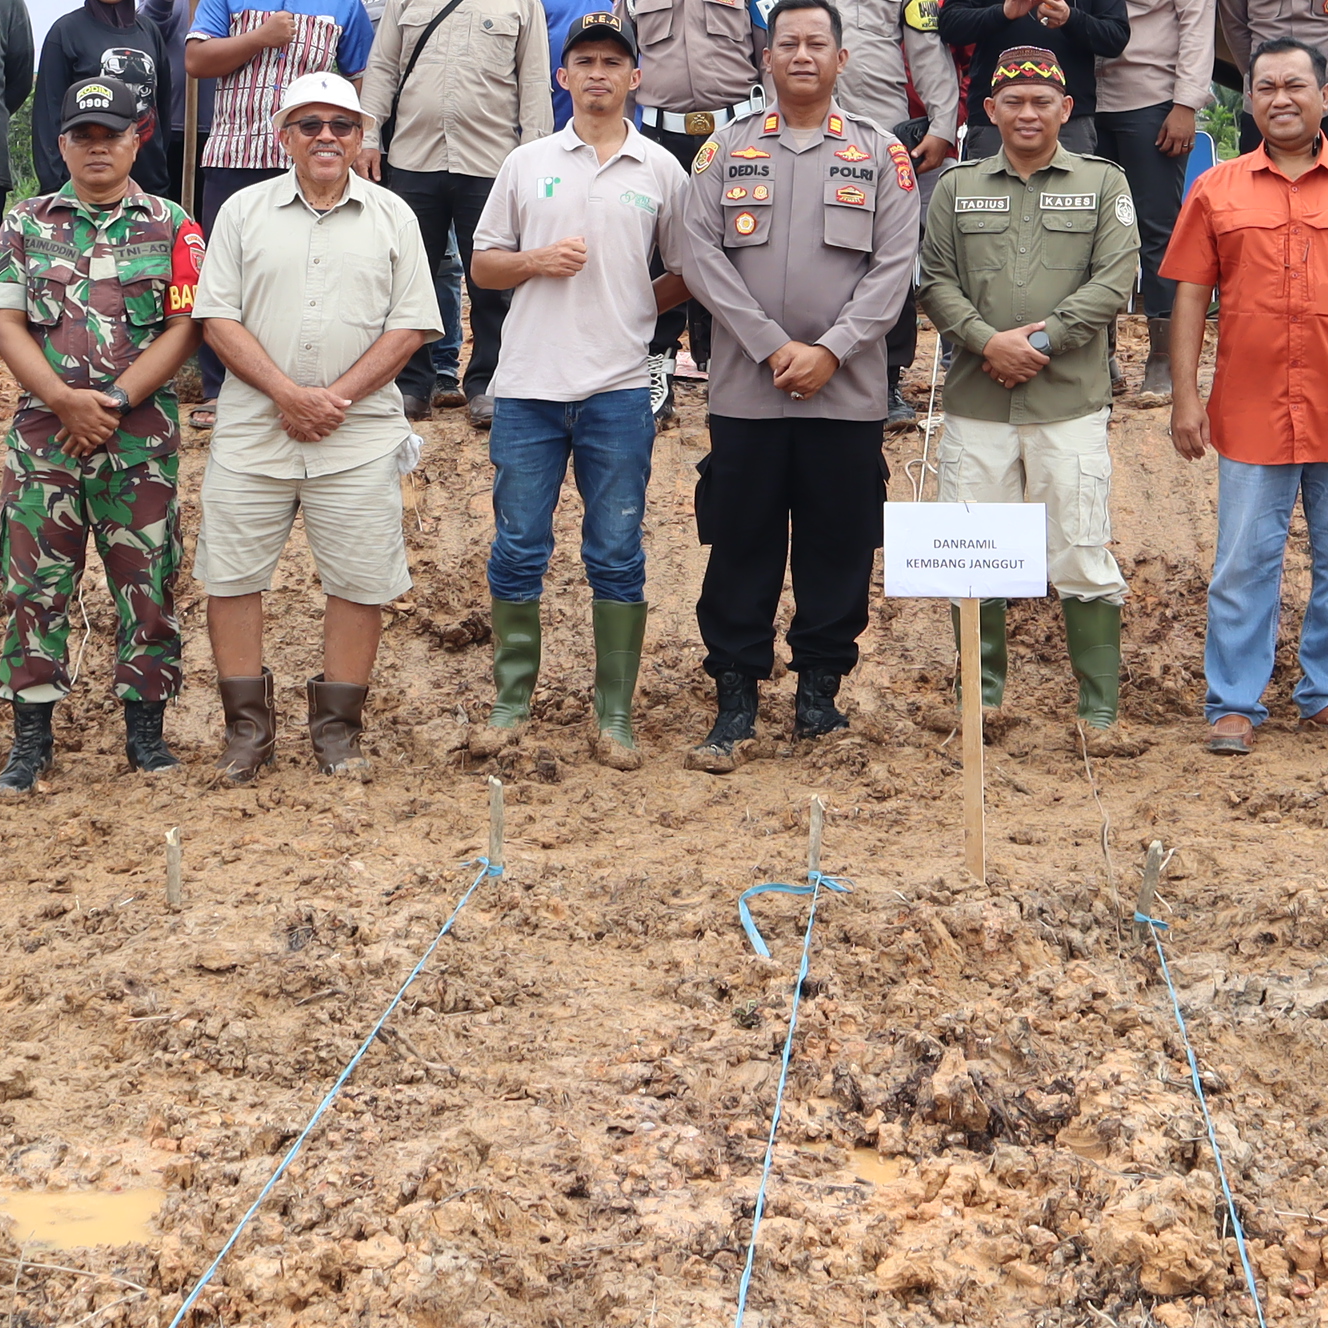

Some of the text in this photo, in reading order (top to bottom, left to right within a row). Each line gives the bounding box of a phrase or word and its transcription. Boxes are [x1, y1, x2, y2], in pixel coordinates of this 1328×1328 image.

[585, 15, 619, 28] R.E.A
[77, 85, 112, 100] KODIM
[79, 98, 110, 110] 0906
[728, 164, 770, 178] DEDI.S
[829, 166, 874, 181] POLRI
[960, 200, 1005, 209] TADIUS
[1045, 197, 1090, 207] KADES
[25, 239, 77, 259] ZAINUDDIN
[933, 538, 998, 549] DANRAMIL
[906, 558, 1025, 570] KEMBANG JANGGUT
